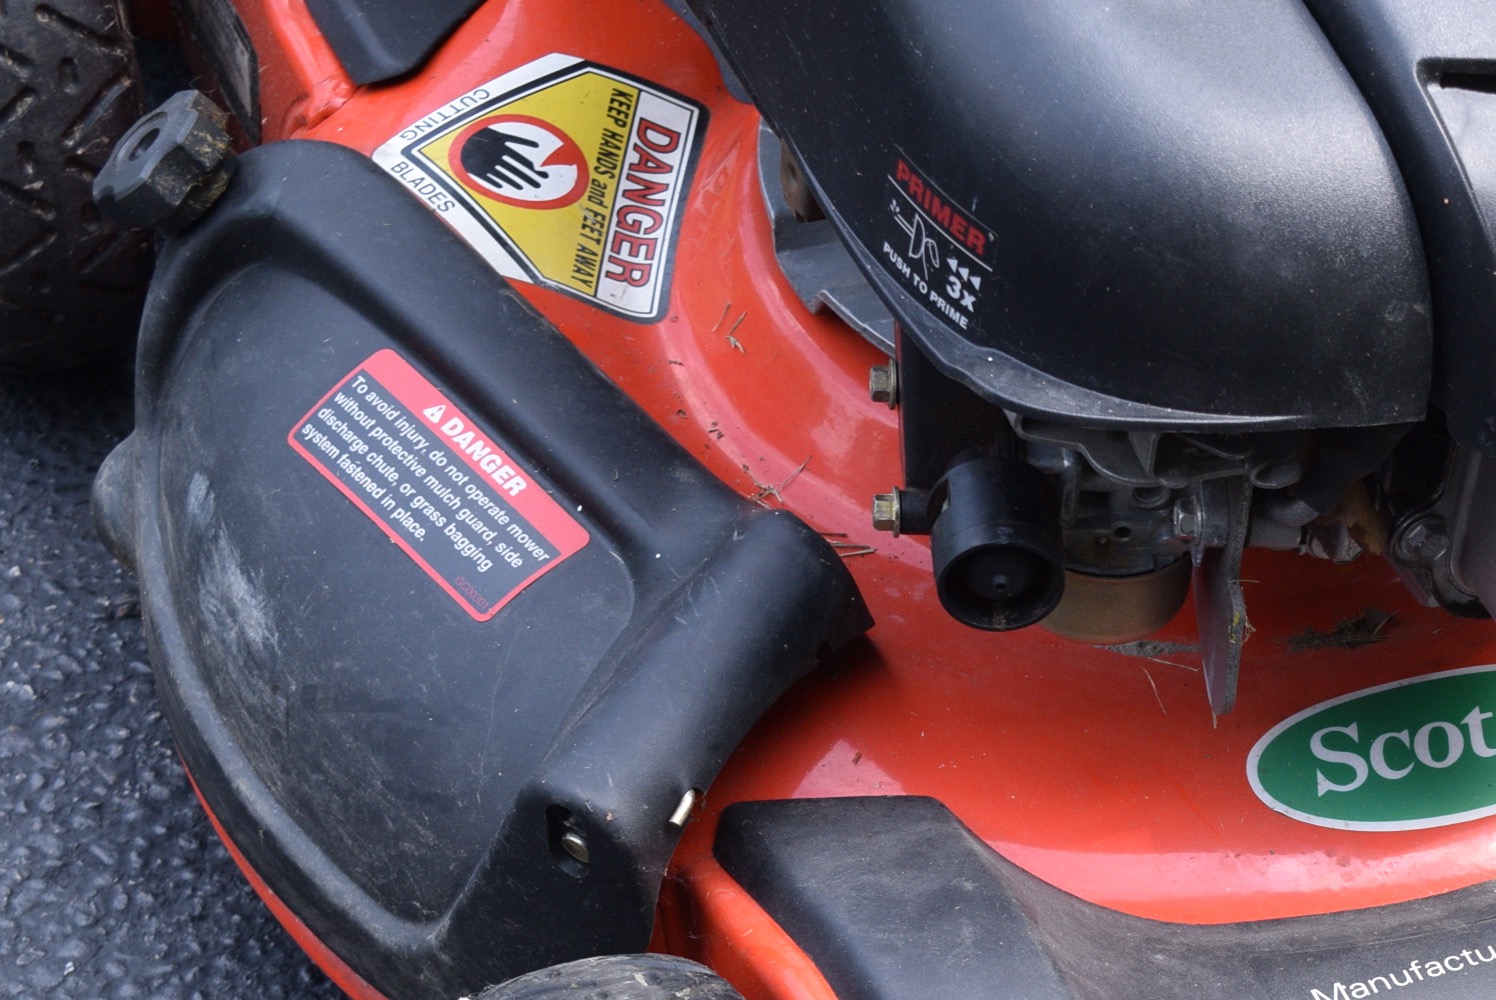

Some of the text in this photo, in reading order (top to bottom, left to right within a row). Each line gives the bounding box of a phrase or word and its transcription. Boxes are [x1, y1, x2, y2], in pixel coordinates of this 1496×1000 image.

[399, 88, 490, 142] CUTTING
[391, 160, 455, 213] BLADES
[571, 87, 634, 288] KEEP HANDS and FEET AWAY
[605, 116, 682, 288] DANGER
[895, 158, 987, 257] PRIMER
[882, 241, 969, 330] PUSH TO PRIME
[301, 423, 426, 542] system fastened in place.
[317, 407, 494, 574] discharge chute, or grass bagging
[333, 391, 524, 569] without protective mulch guard, side
[350, 375, 552, 563] To avoid injury, do not operate mower
[441, 416, 528, 497] DANGER
